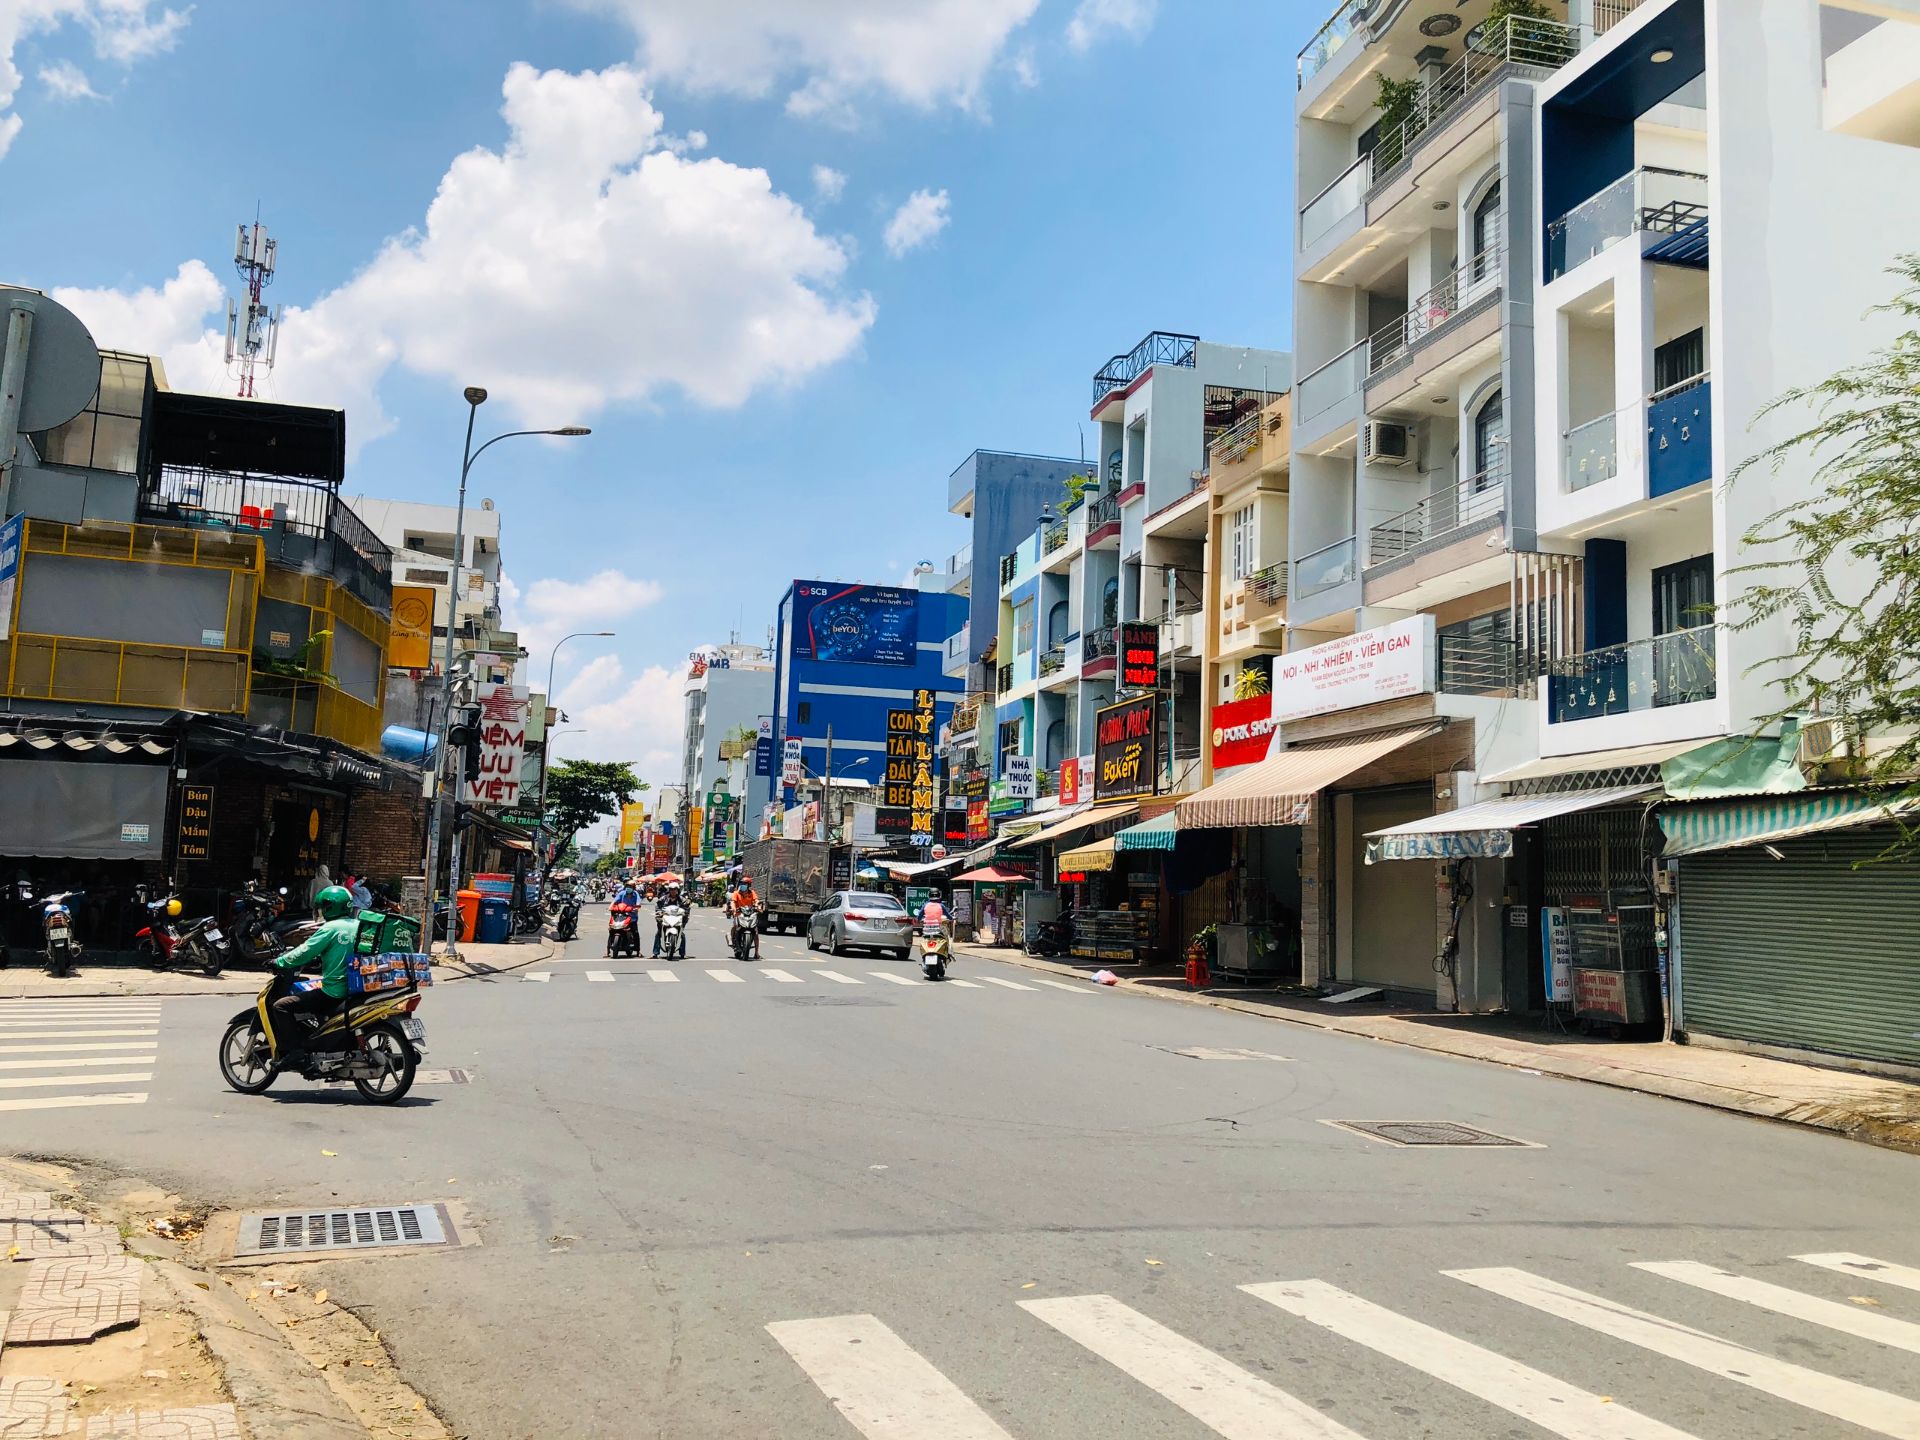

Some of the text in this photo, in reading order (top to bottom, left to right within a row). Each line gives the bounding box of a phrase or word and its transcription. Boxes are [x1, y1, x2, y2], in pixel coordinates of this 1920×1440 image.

[810, 588, 828, 596] SCB
[708, 658, 730, 669] MB
[1283, 665, 1298, 681] NỘI
[1304, 661, 1319, 675] NHI
[1361, 640, 1385, 659] VIÊM
[1388, 634, 1411, 652] GAN
[1223, 723, 1251, 743] PORK
[480, 752, 513, 774] ƯU
[1011, 756, 1030, 770] NHÀ
[1103, 757, 1140, 782] Bakery
[1008, 769, 1032, 783] THUỐC
[187, 790, 209, 801] Bún
[470, 777, 519, 804] VIỆT
[1011, 783, 1029, 795] TÂY
[186, 806, 207, 820] Đậu
[181, 824, 209, 837] Mắm
[181, 844, 206, 855] Tôm
